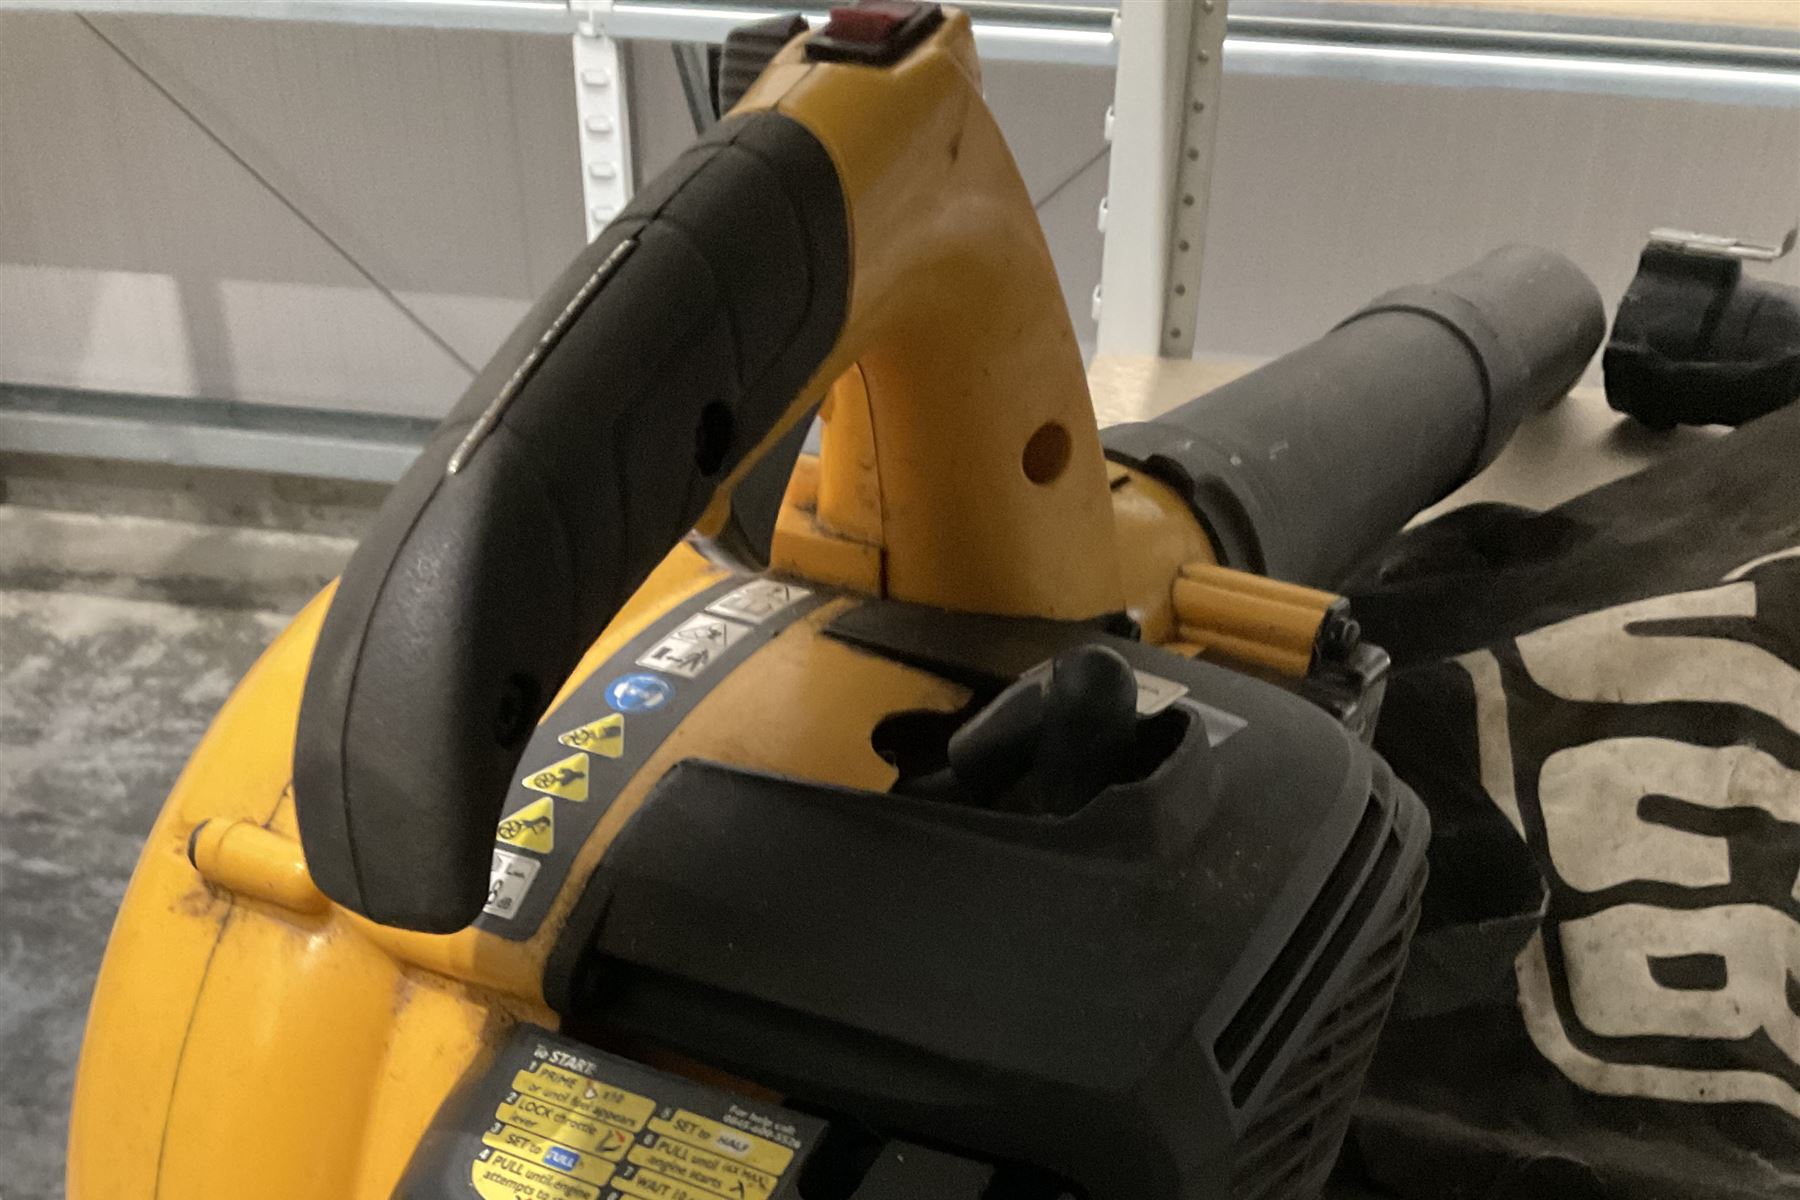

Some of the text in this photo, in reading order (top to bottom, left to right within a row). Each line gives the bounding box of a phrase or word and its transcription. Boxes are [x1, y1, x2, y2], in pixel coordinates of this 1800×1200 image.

[529, 1060, 537, 1071] 1
[538, 1068, 578, 1089] PRIME
[506, 1091, 518, 1103] 2
[518, 1102, 553, 1118] LOCK
[543, 1089, 569, 1103] until
[592, 1106, 636, 1127] appears
[661, 1107, 672, 1119] 5
[490, 1122, 502, 1133] 3
[510, 1115, 537, 1127] lever
[674, 1118, 698, 1134] SET
[698, 1129, 711, 1139] to
[716, 1135, 750, 1152] HALF
[479, 1149, 490, 1160] 4
[505, 1134, 576, 1168] SET to FULL
[658, 1141, 689, 1160] PULL
[690, 1156, 720, 1170] until
[492, 1155, 591, 1200] PULL until engine
[623, 1165, 634, 1178] 7
[647, 1156, 722, 1188] engine starts
[483, 1171, 535, 1196] attempts
[536, 1190, 549, 1200] to
[637, 1174, 671, 1196] WAIT
[672, 1188, 687, 1200] 10
